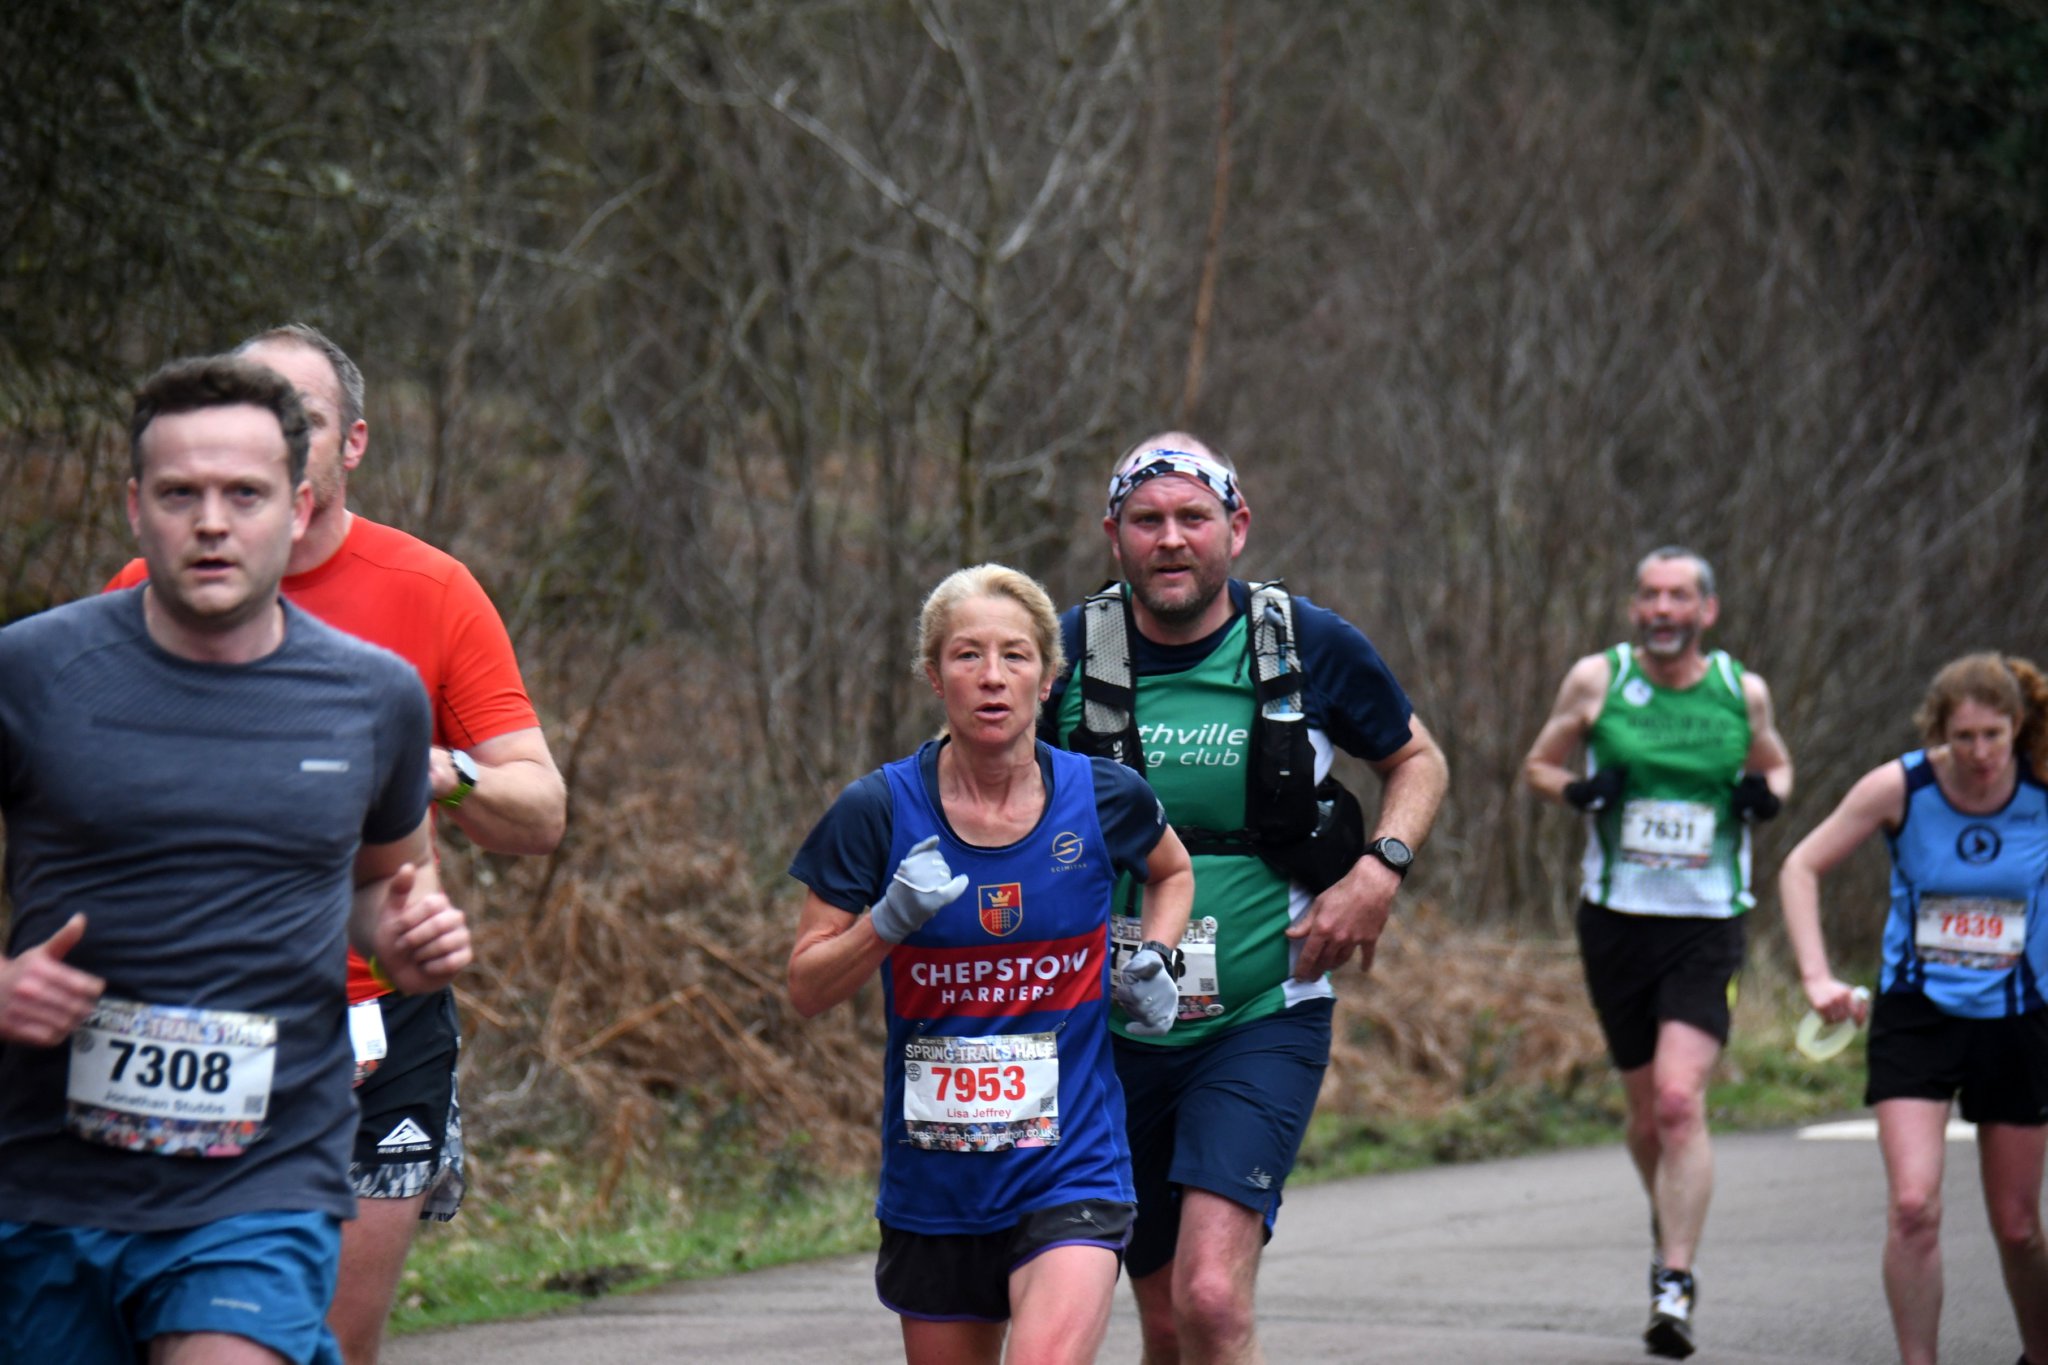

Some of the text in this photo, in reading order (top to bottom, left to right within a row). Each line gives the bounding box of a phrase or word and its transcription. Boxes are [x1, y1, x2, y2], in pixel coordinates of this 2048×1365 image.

[1138, 723, 1248, 745] thville
[1180, 748, 1240, 766] club
[1940, 911, 2004, 939] 7839
[911, 948, 1089, 986] CHEPSTOW
[941, 984, 1054, 1004] HARRIERS
[905, 1042, 1054, 1061] SPRING TRAILS HALF
[108, 1039, 231, 1094] 7308
[931, 1066, 1026, 1102] 7953
[947, 1108, 1011, 1119] Lisa Jeffrey
